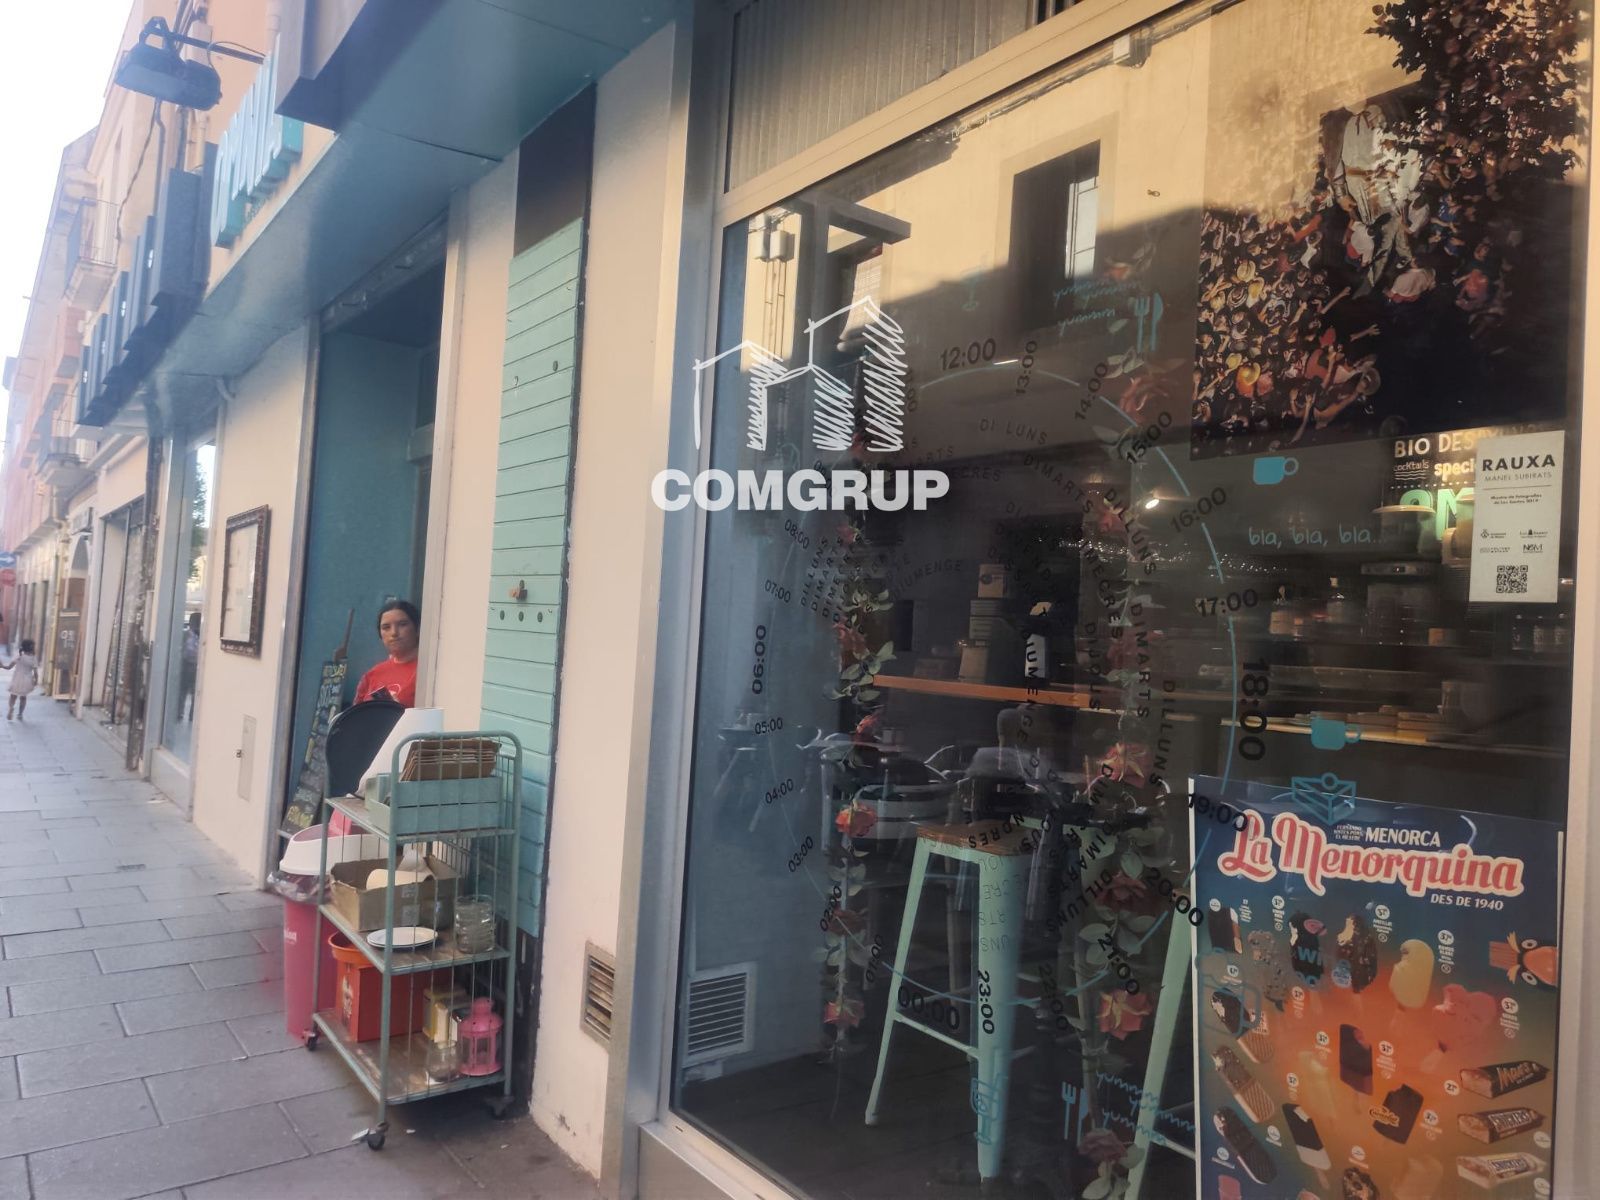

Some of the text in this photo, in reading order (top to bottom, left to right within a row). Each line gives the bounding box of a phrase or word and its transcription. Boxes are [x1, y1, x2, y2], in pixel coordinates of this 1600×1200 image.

[940, 338, 997, 371] 12:00
[1015, 339, 1038, 395] 13:00
[1074, 362, 1108, 421] 14:00
[1126, 410, 1173, 465] 15:00
[1394, 437, 1431, 459] BIO
[1023, 453, 1096, 514] DIMARTS
[1434, 457, 1476, 482] speci
[1482, 454, 1556, 472] RAUXA
[1485, 471, 1553, 482] MANEL SUBIRATS
[1104, 488, 1157, 575] DILLUNS
[1170, 487, 1227, 533] 16:00
[784, 518, 810, 550] 08:00
[1248, 526, 1282, 550] bla,
[1290, 526, 1328, 547] bla,
[764, 579, 792, 603] 07:00
[800, 536, 829, 608] DILLUNS
[1197, 588, 1258, 617] 17:00
[751, 624, 767, 694] 06:00
[1130, 602, 1152, 719] DIMARTS
[754, 717, 784, 735] 05:00
[1149, 679, 1176, 784] DILLUNS
[1238, 658, 1269, 761] 18:00
[764, 778, 795, 805] 04:00
[1188, 793, 1248, 832] 19:00
[787, 837, 815, 874] 03:00
[1218, 809, 1525, 896] La Menorquina
[1366, 827, 1441, 847] MENORCA
[819, 885, 843, 933] 02:00
[1143, 867, 1204, 927] 20:00
[1431, 894, 1504, 910] DES DE 1940
[865, 934, 885, 984] 01:00
[1098, 932, 1140, 996] 21:00
[898, 985, 960, 1031] 00:00
[978, 970, 995, 1035] 23:00
[1038, 963, 1069, 1031] 22:00
